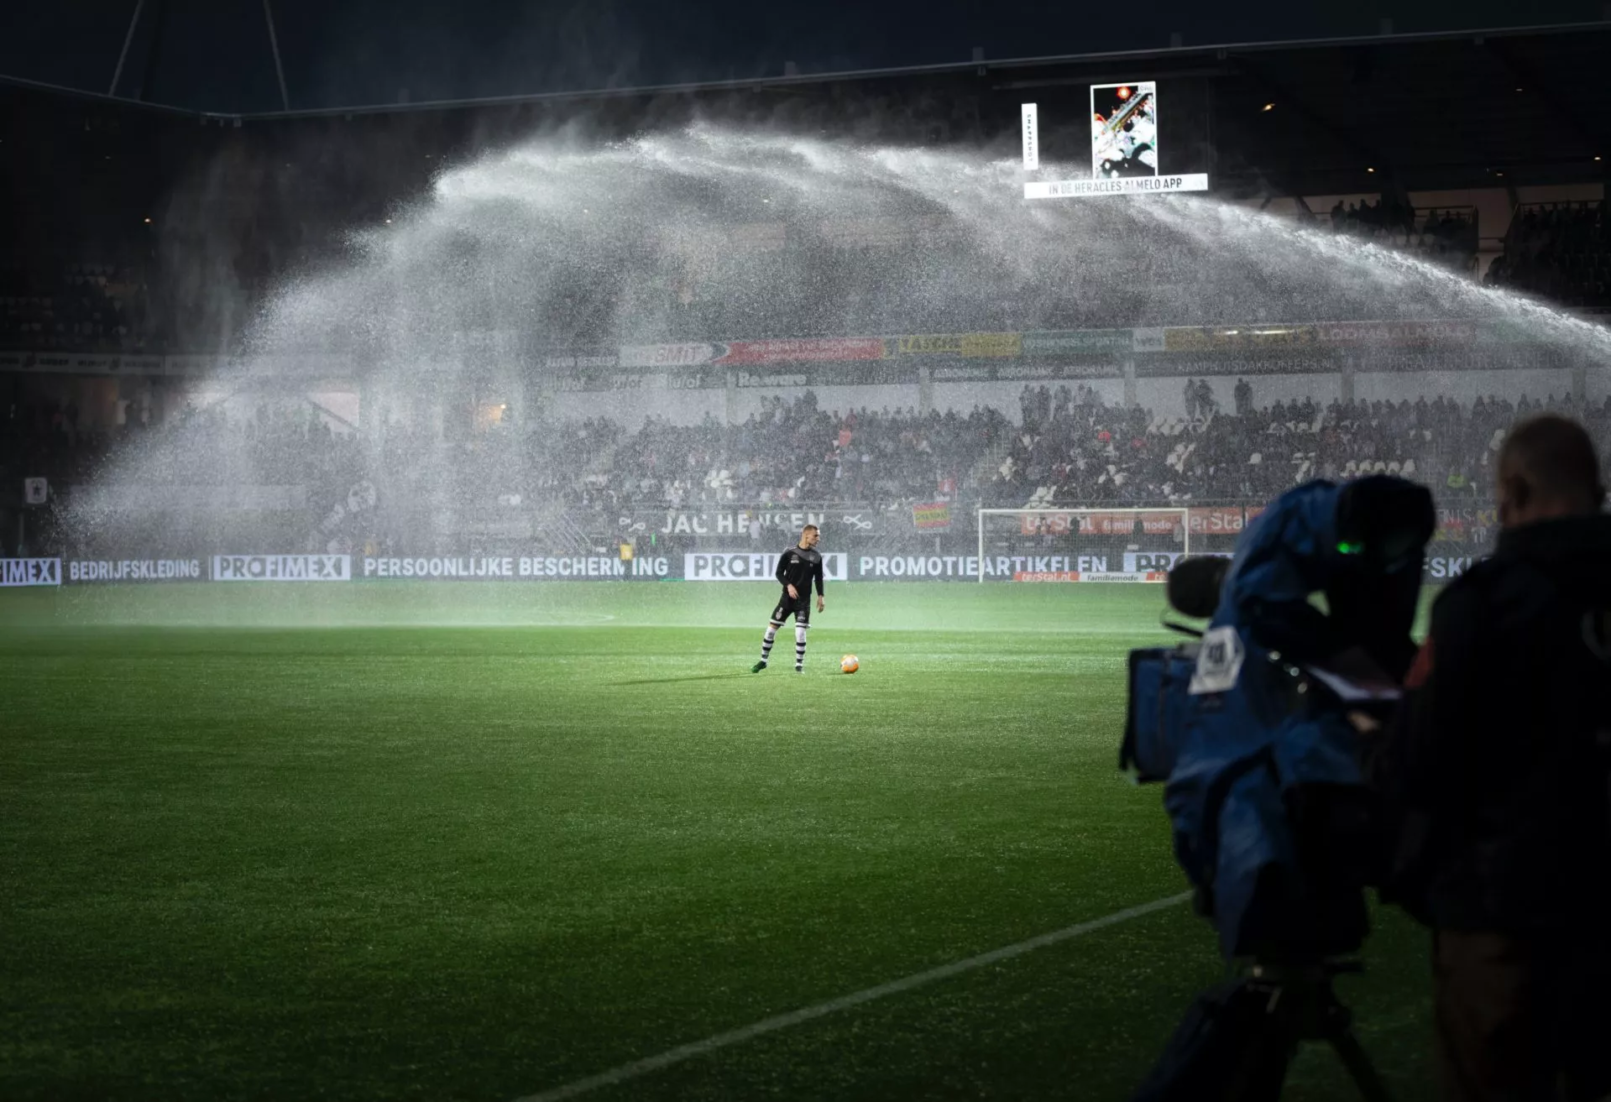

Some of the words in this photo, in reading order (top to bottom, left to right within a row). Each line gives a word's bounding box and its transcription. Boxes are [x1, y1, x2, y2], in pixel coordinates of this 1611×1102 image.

[1049, 184, 1058, 195] IN
[1075, 181, 1122, 193] HERACLES
[1163, 177, 1183, 189] APP
[70, 560, 200, 580] BEDRIJFSKLEDING
[220, 557, 343, 578] PROFIMEX
[364, 558, 513, 576] PERSOONLIJKE
